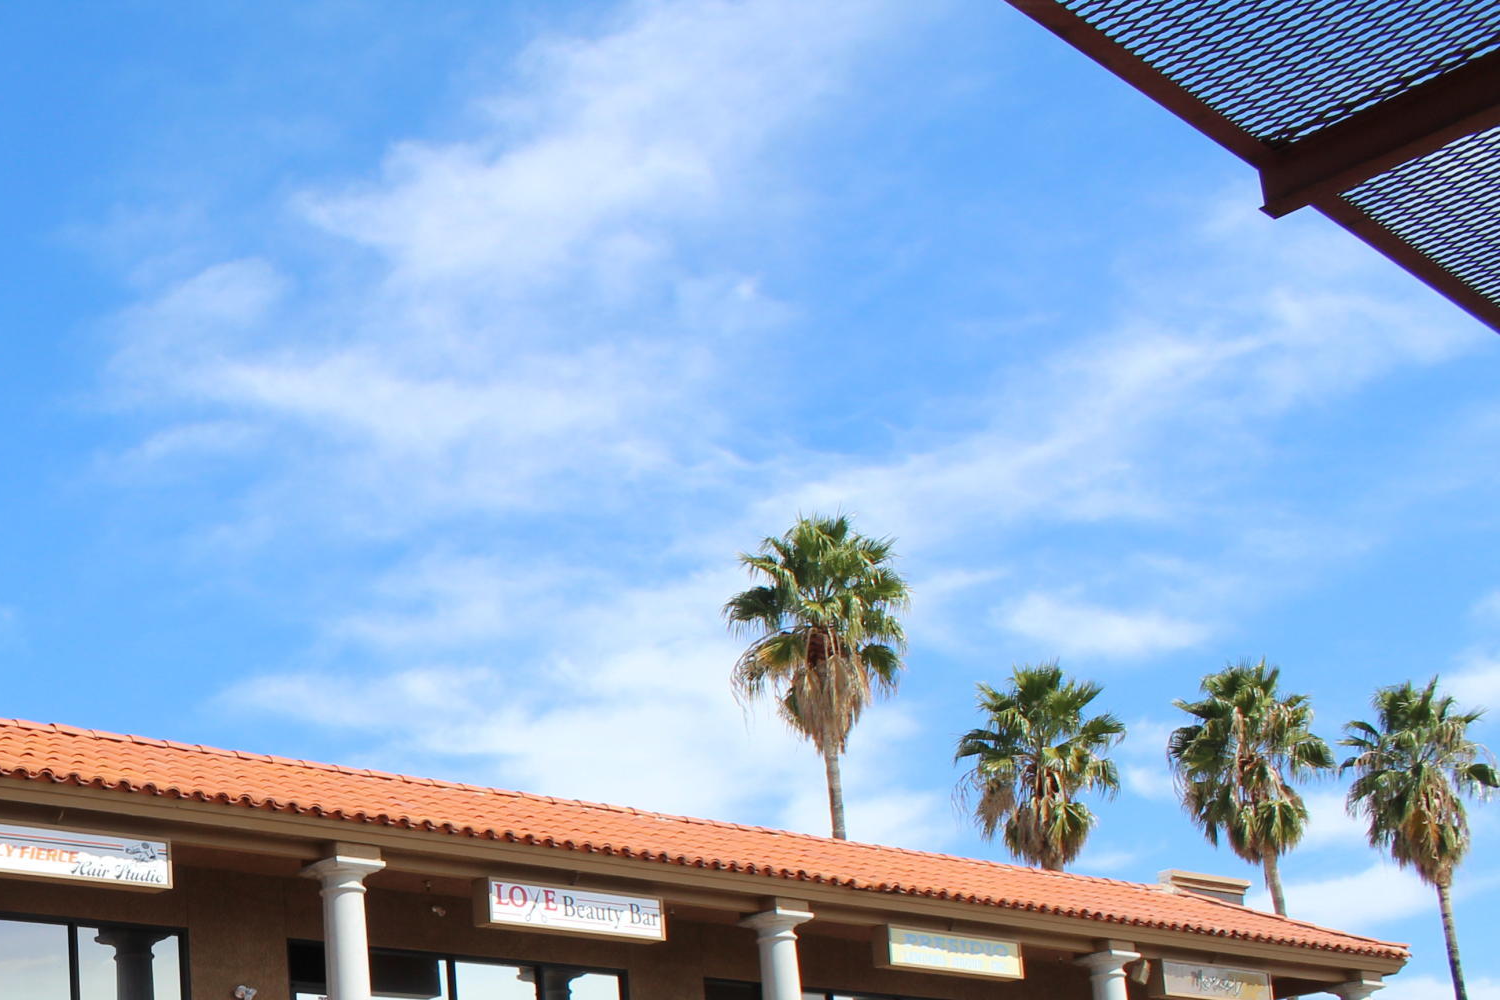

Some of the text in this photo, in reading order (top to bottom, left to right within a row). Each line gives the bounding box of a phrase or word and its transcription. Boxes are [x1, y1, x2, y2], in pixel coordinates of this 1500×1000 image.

[19, 845, 80, 864] FIERCE
[70, 860, 164, 883] Hair Studio
[562, 895, 623, 929] Beauty
[628, 903, 659, 927] Bar
[903, 933, 1009, 957] PRESIDIO
